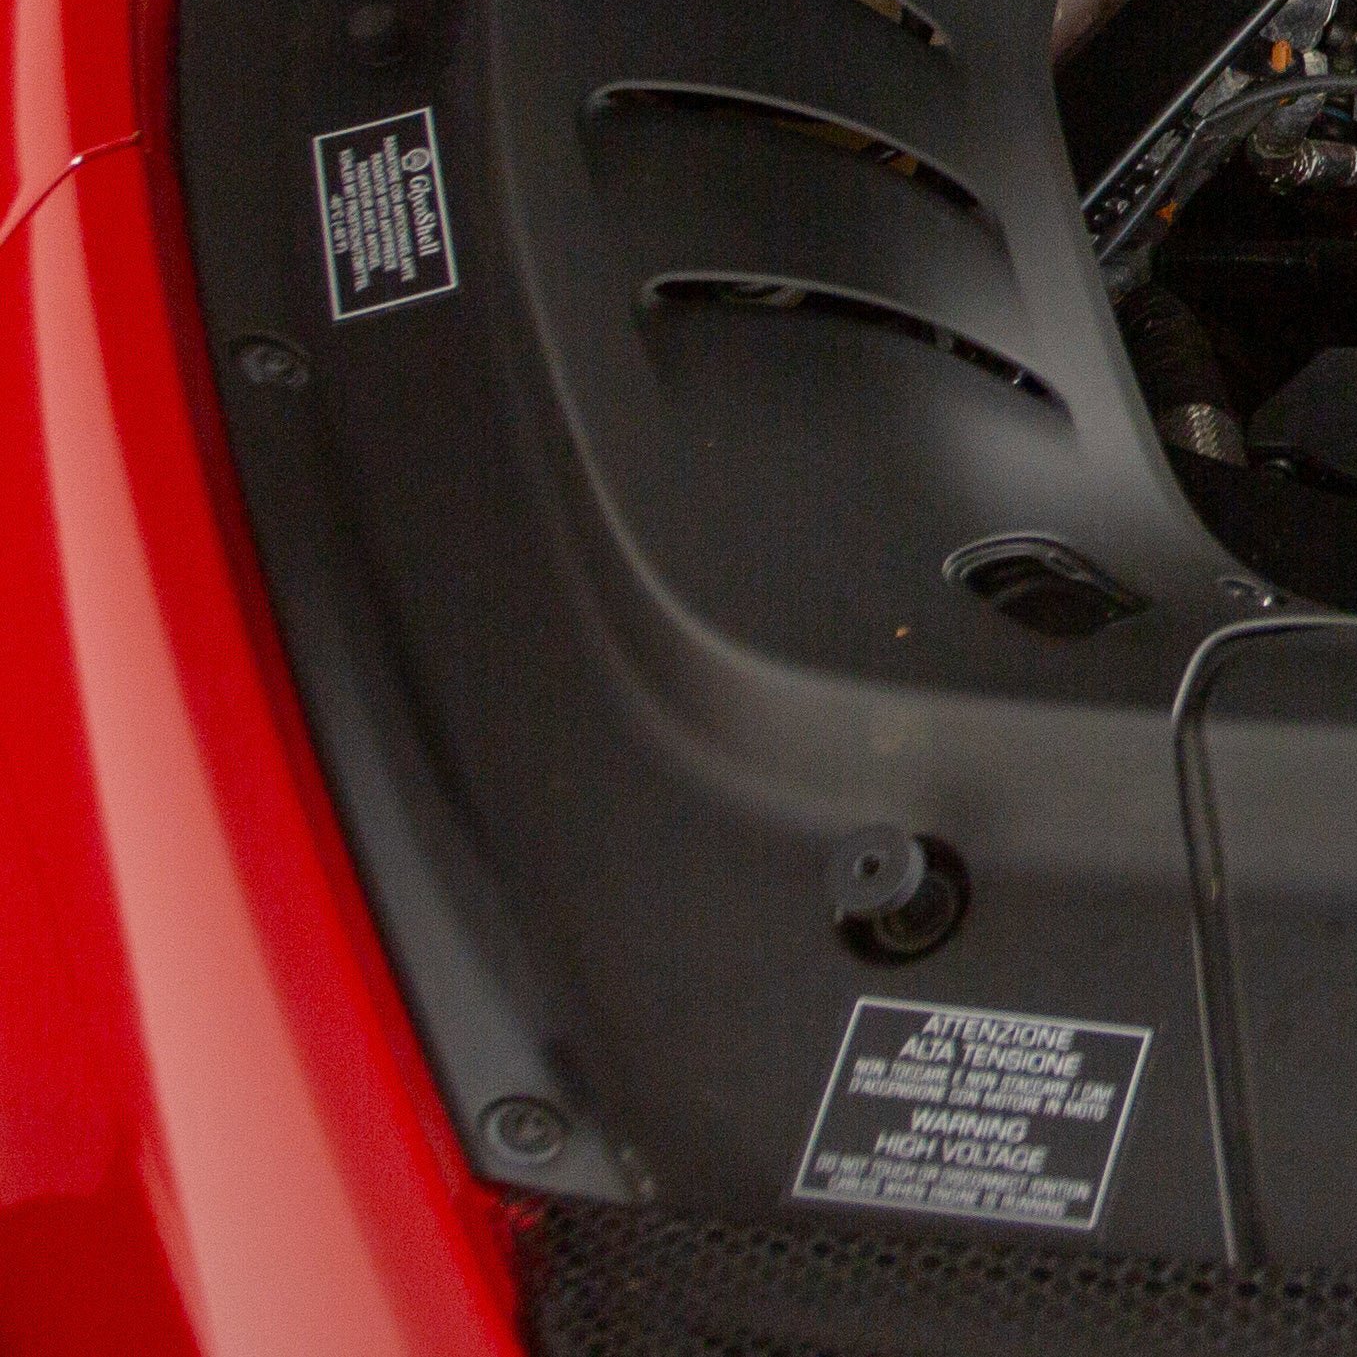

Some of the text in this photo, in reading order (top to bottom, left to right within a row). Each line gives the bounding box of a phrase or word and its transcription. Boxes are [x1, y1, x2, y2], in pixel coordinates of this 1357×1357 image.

[920, 1013, 1076, 1051] ATTENZIONE
[897, 1033, 1085, 1078] ALTA TENSIONE
[906, 1105, 1032, 1144] WARNING
[872, 1128, 1049, 1173] HIGH VOLTAGE
